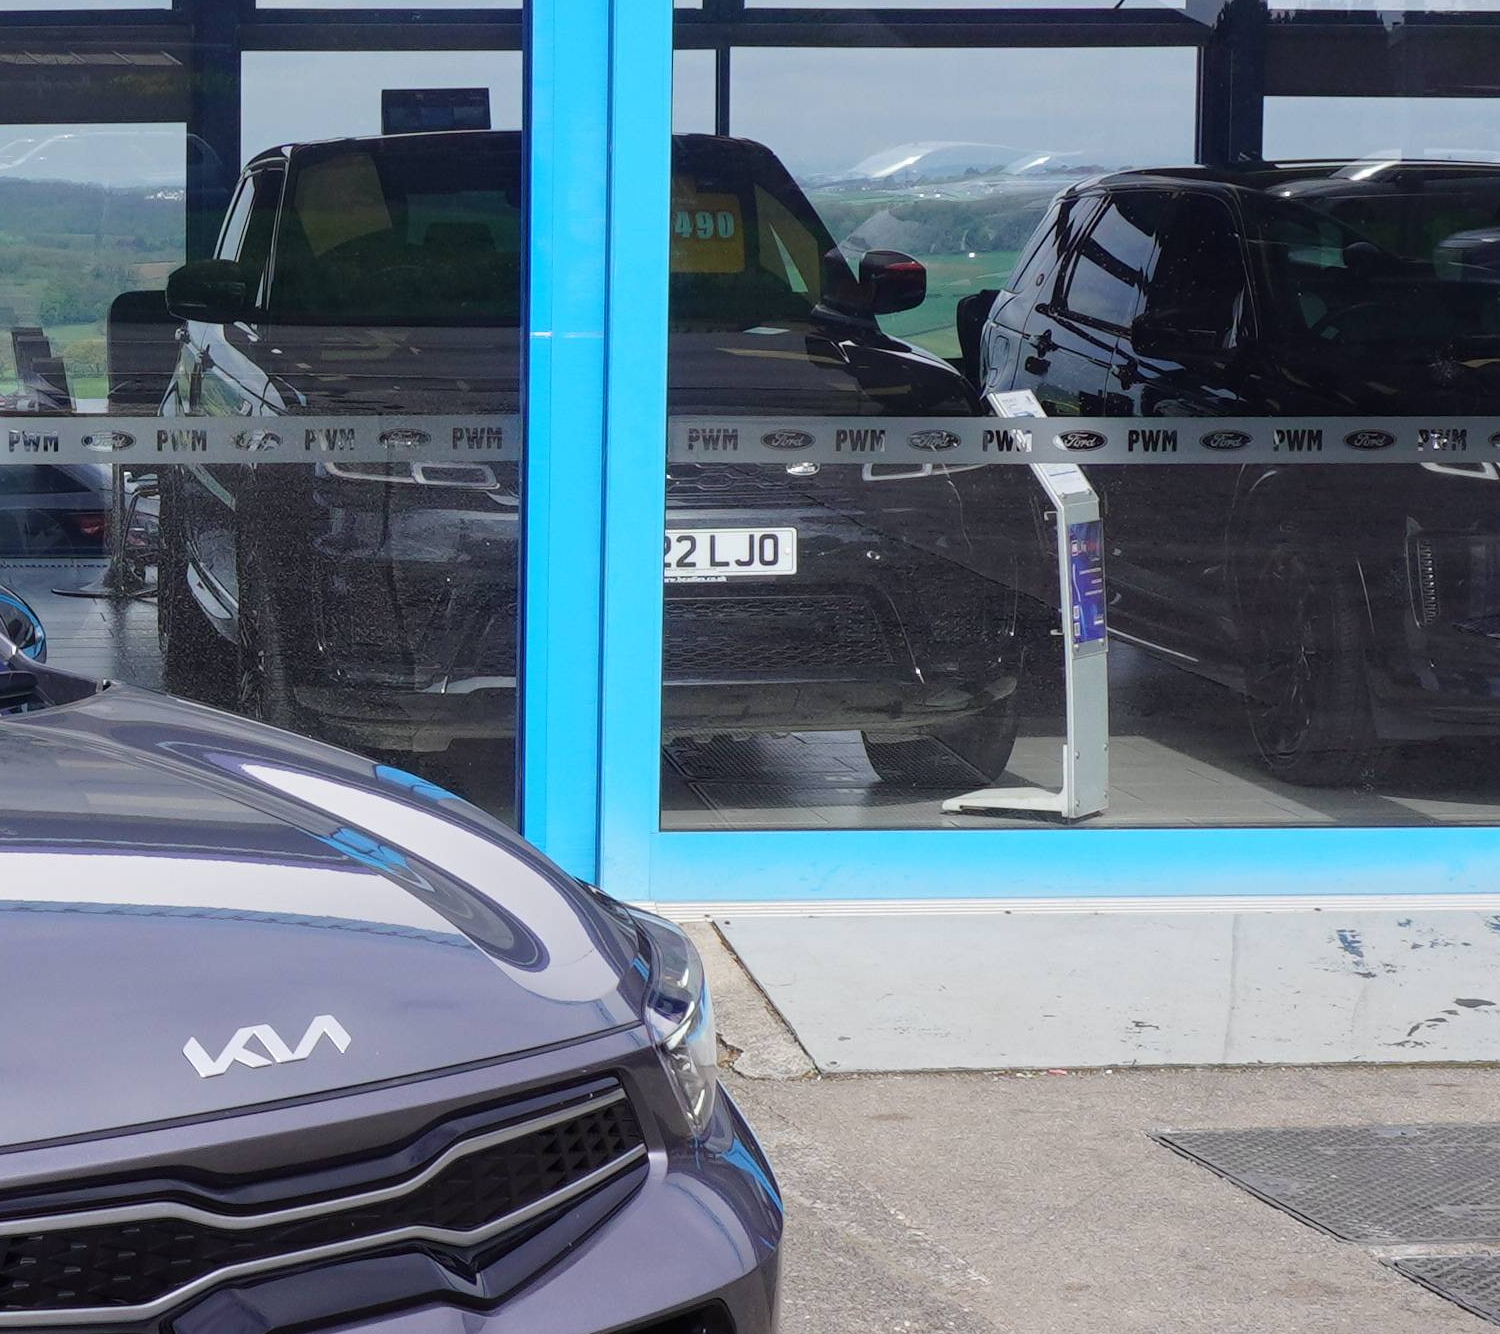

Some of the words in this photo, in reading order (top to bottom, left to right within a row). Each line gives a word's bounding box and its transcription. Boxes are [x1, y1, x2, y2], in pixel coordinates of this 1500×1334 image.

[9, 430, 59, 452] PWM
[157, 430, 207, 452] PWM
[452, 427, 503, 449] PWM
[688, 429, 738, 451] PWM
[763, 431, 812, 449] Ford
[835, 429, 886, 452] PWM
[1055, 431, 1105, 450] Ford
[1128, 430, 1178, 452] PWM
[1202, 431, 1251, 450] Ford
[1346, 431, 1394, 450] Ford
[710, 534, 779, 567] LJO
